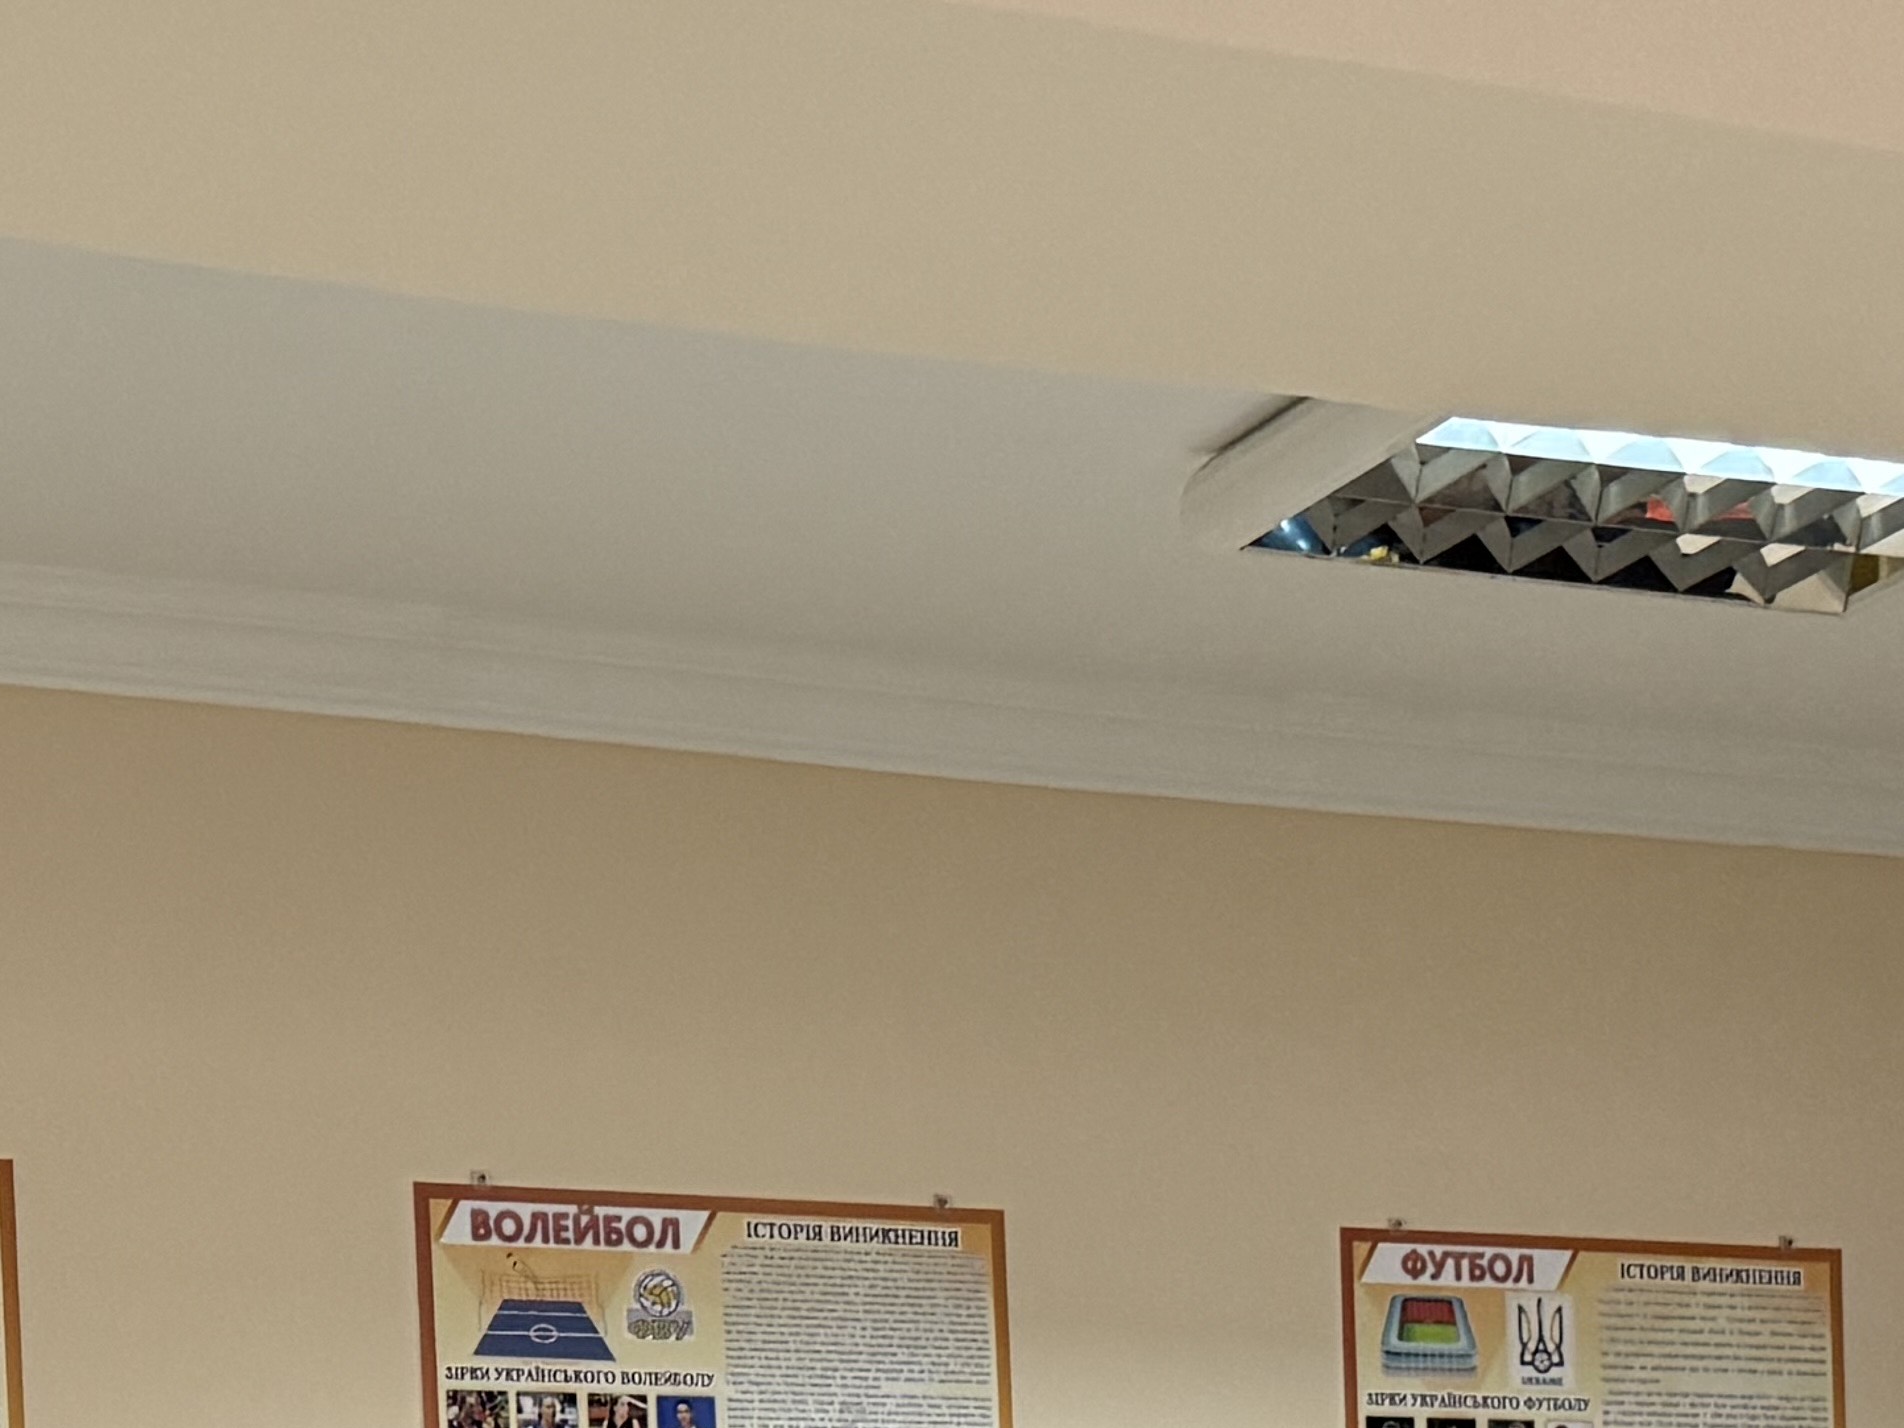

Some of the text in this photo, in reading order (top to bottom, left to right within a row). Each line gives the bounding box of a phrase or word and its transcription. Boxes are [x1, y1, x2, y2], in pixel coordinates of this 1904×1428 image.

[470, 1204, 681, 1250] ВОЛЕЙБОЛ
[746, 1221, 960, 1248] ІСТОРІЯ ВИНИКНЕННЯ
[1401, 1249, 1535, 1285] ФУТБОЛ
[1620, 1263, 1802, 1286] ІСТОРІЯ ВИНИКНЕННЯ
[445, 1366, 715, 1388] ЗІРКИ УКРАЇНСЬКОГО ВОЛЕЙБОЛУ
[1366, 1391, 1591, 1412] ЗІРКИ УКРАЇНСЬКОГО ФУТБОЛУ
